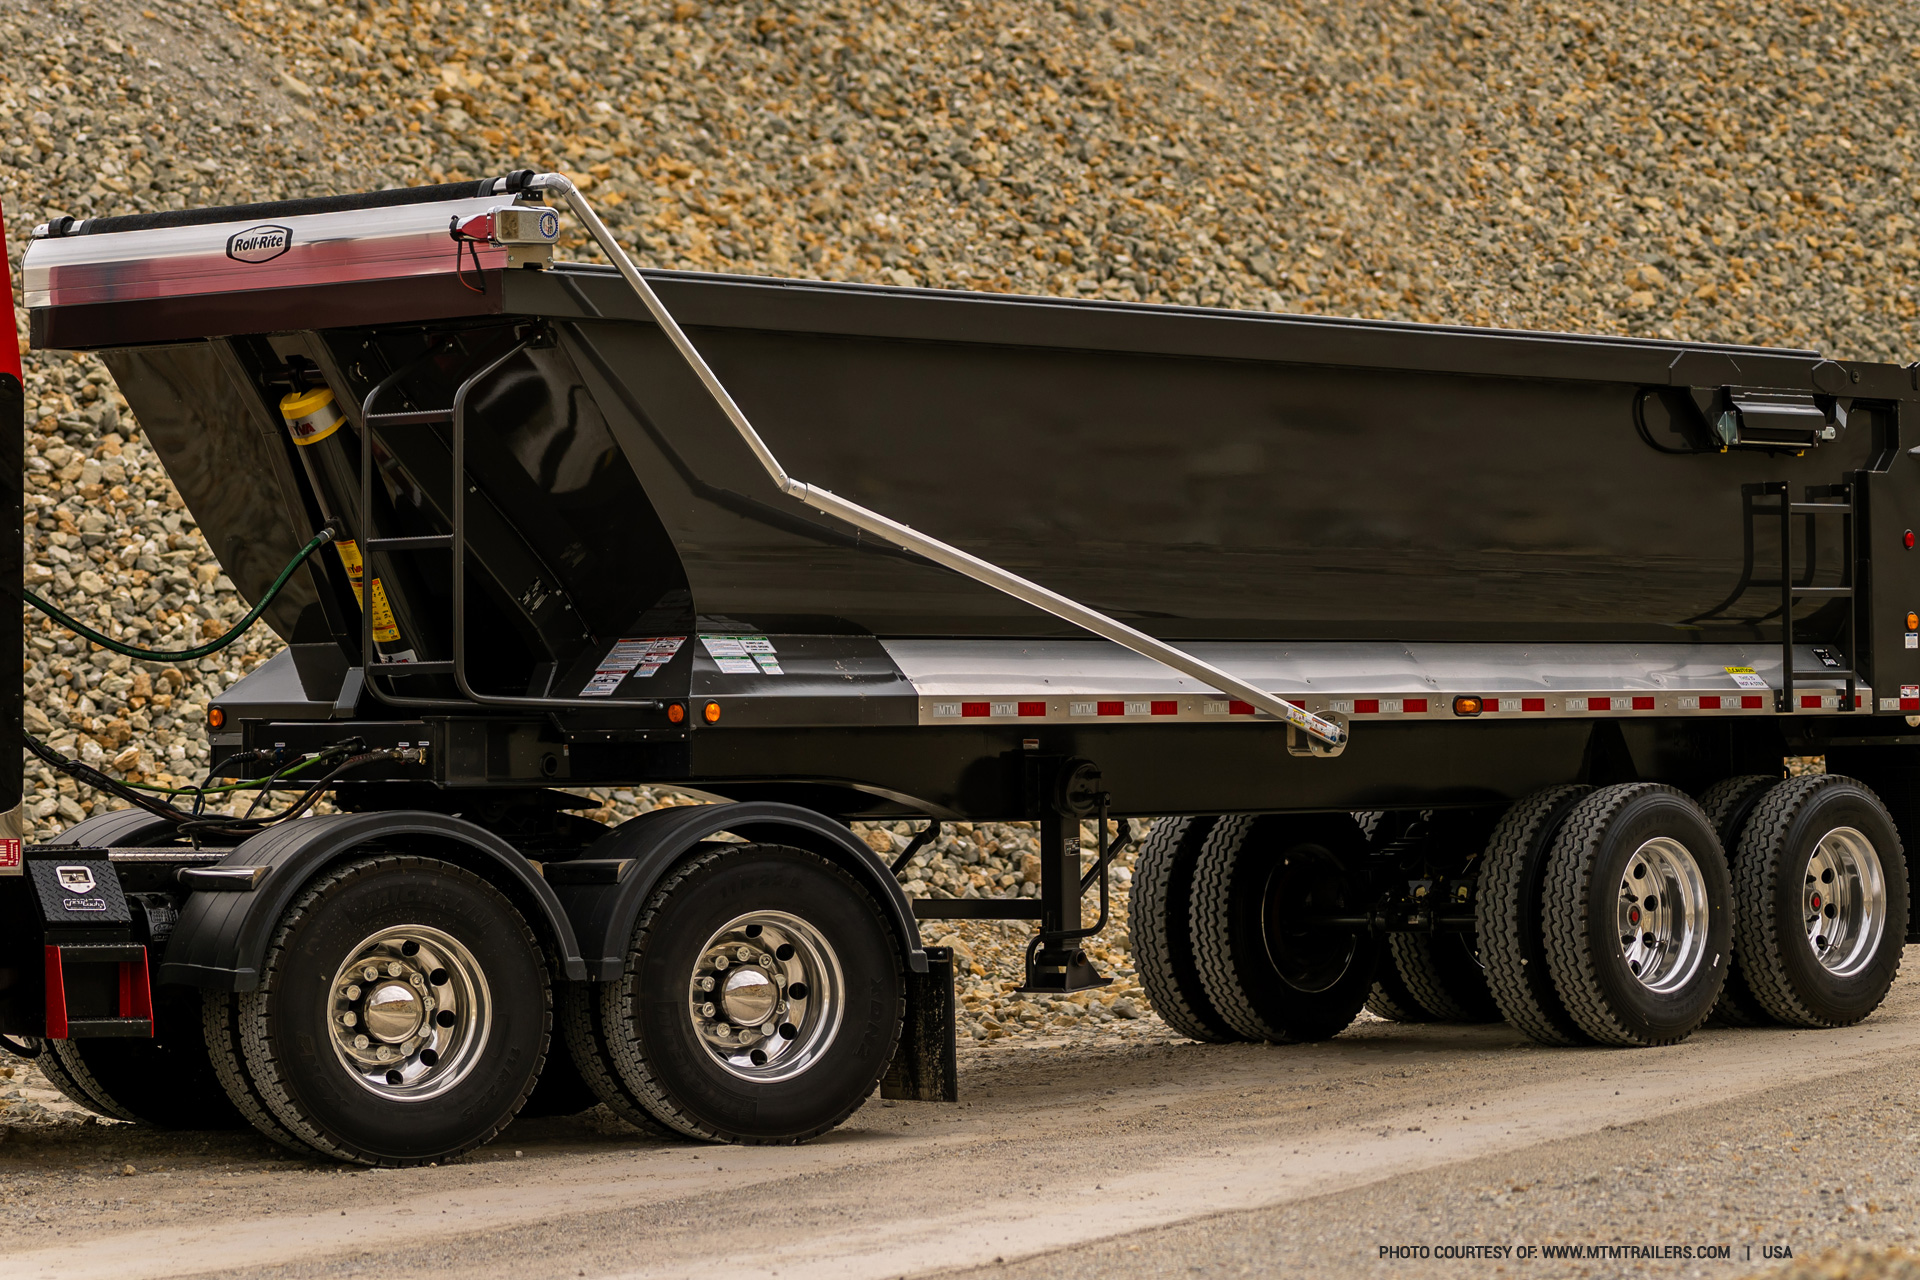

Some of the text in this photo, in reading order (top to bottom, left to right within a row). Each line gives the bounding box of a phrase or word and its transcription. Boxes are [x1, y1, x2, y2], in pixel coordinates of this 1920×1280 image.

[1075, 704, 1093, 714] MTM
[1129, 703, 1146, 713] MTM
[1208, 703, 1225, 712] MTM
[1334, 702, 1350, 711] MTM
[1383, 701, 1399, 711] MTM
[1503, 700, 1518, 710] MTM
[1570, 700, 1584, 709] MTM
[1614, 699, 1628, 708] MTM
[939, 705, 956, 715] MTM
[995, 704, 1013, 715] MTM
